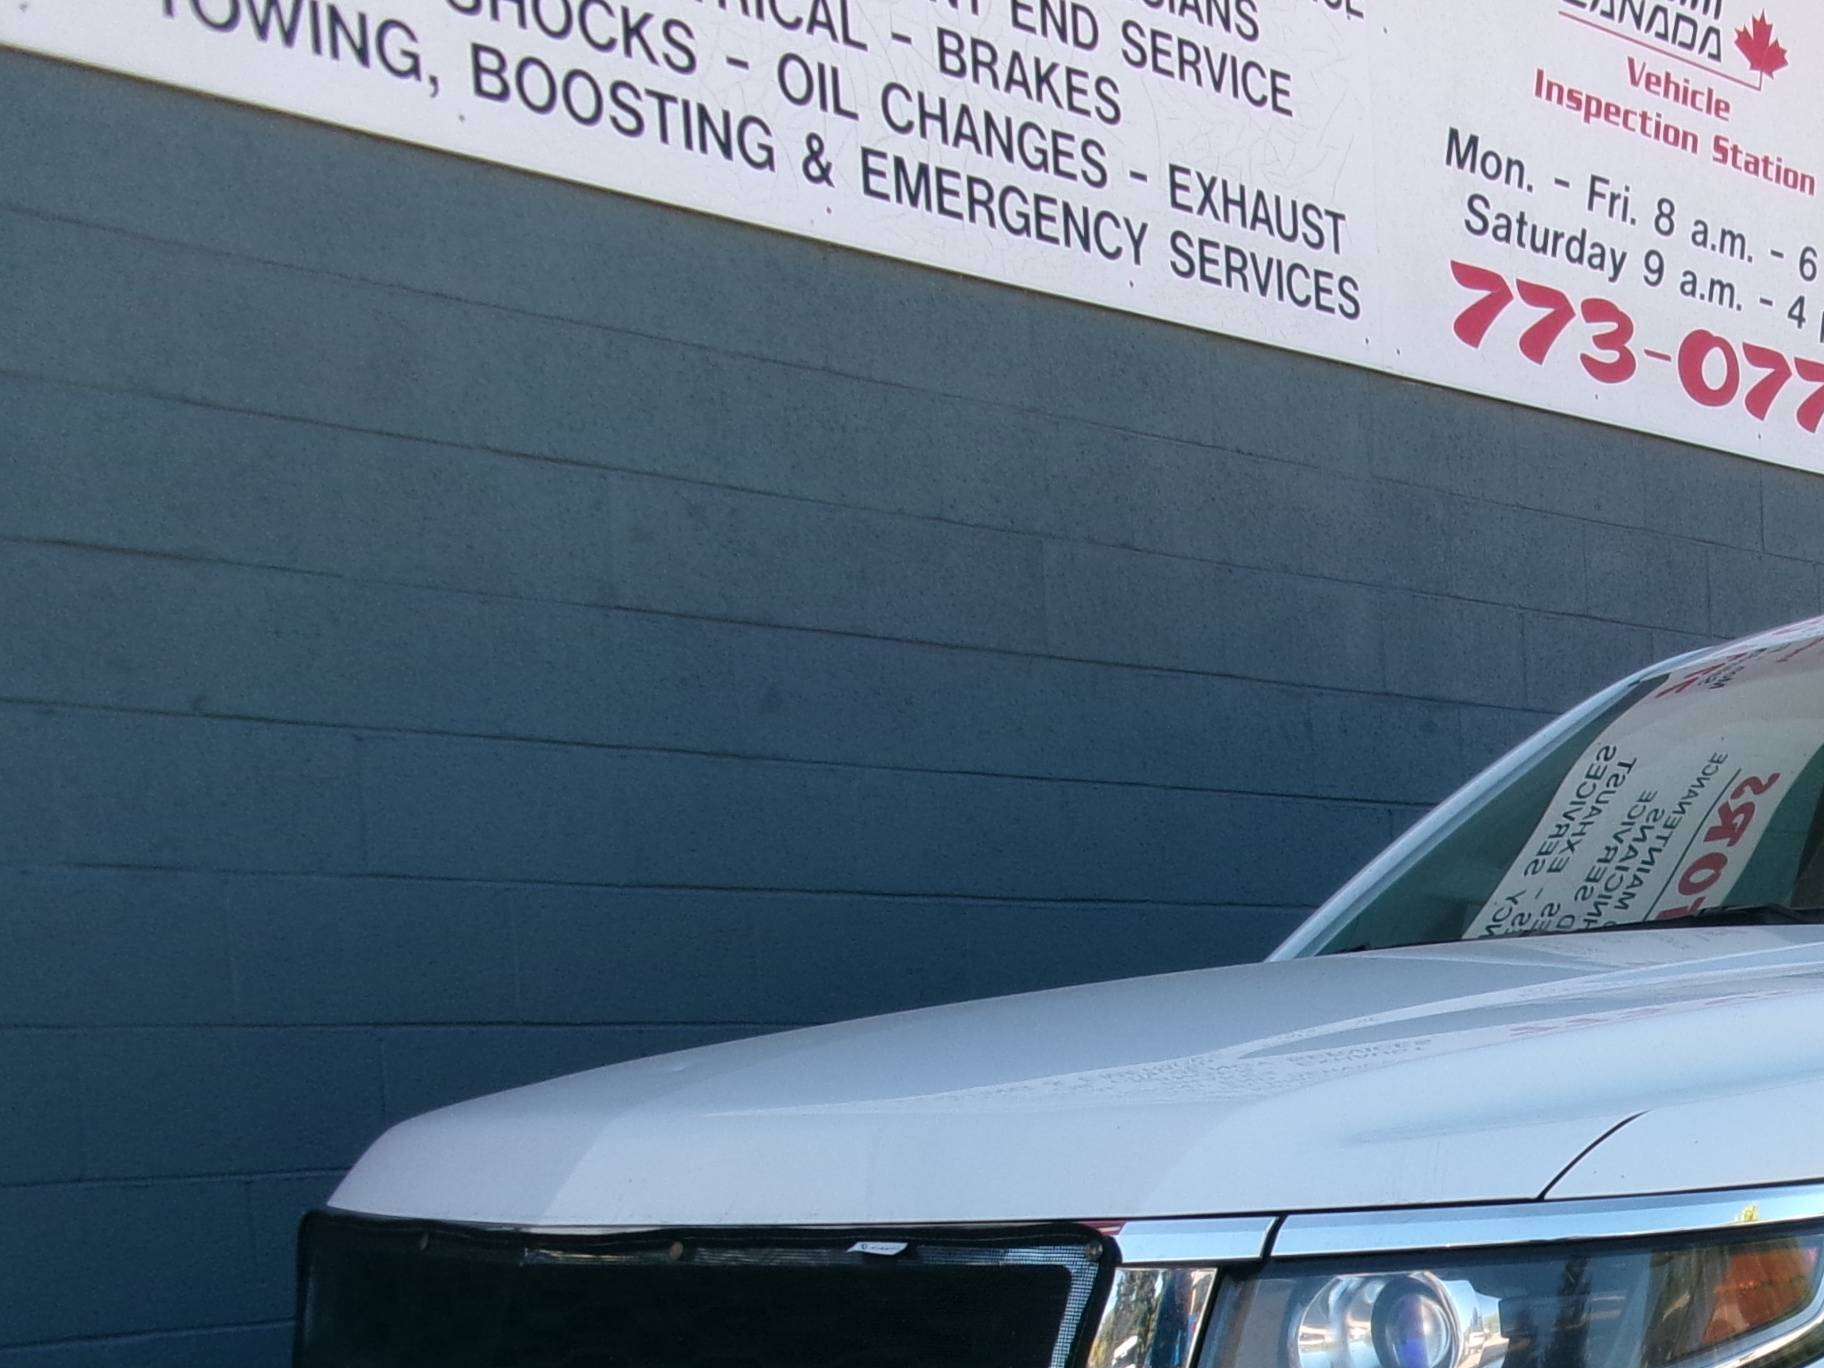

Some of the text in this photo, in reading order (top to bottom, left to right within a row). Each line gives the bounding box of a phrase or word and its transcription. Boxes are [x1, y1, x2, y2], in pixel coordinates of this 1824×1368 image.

[937, 27, 1121, 125] BRAKES
[1011, 0, 1293, 117] END SERVICE
[1562, 0, 1722, 63] ANADA
[1626, 56, 1731, 122] Vehicle
[470, 42, 776, 172] BOOSTING
[802, 132, 836, 188] &
[861, 146, 1149, 266] EMERGENCY
[1170, 229, 1361, 321] SERVICES
[777, 52, 859, 120] OIL
[881, 82, 1108, 188] CHANGES
[1168, 163, 1346, 254] EXHAUST
[1534, 68, 1817, 196] Inspection Station
[1445, 126, 1534, 193] Mon.
[1587, 174, 1637, 226] Fri.
[1654, 198, 1675, 237] 8
[1691, 220, 1753, 262] a.m.
[1799, 246, 1818, 283] 6
[1464, 193, 1628, 284] Saturday
[1643, 249, 1664, 287] 9
[1679, 270, 1742, 312] a.m.
[1787, 294, 1806, 330] 4
